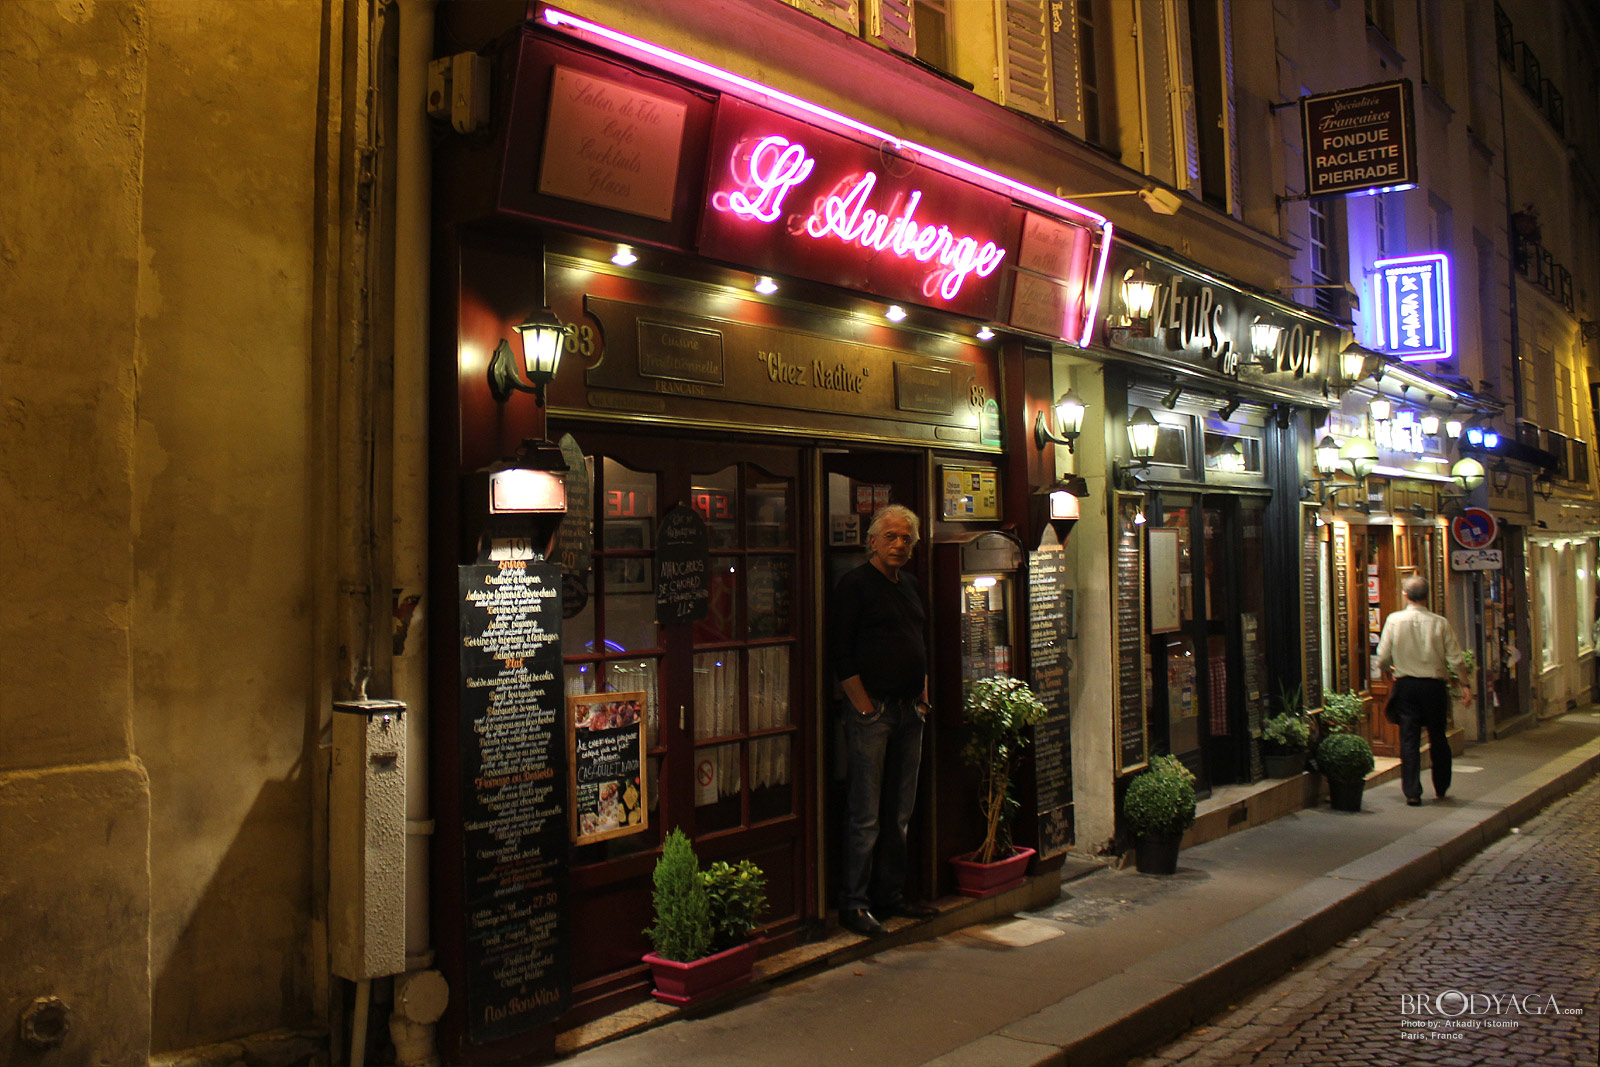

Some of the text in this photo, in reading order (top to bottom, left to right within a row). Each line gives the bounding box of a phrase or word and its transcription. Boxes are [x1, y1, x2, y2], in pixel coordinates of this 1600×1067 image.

[570, 79, 614, 113] Salon
[619, 98, 634, 117] de
[1331, 97, 1380, 115] Spécialités
[602, 119, 639, 145] Café
[1318, 111, 1391, 130] Françaises
[1323, 129, 1389, 150] FONDUE
[576, 137, 641, 173] Cocktails
[1316, 145, 1399, 168] RACLETTE
[583, 166, 631, 197] Glaces
[1319, 163, 1399, 185] PIERRADE
[807, 171, 1006, 300] Auberge
[565, 323, 595, 357] 83
[661, 333, 700, 350] Cuisine
[971, 385, 986, 407] 83
